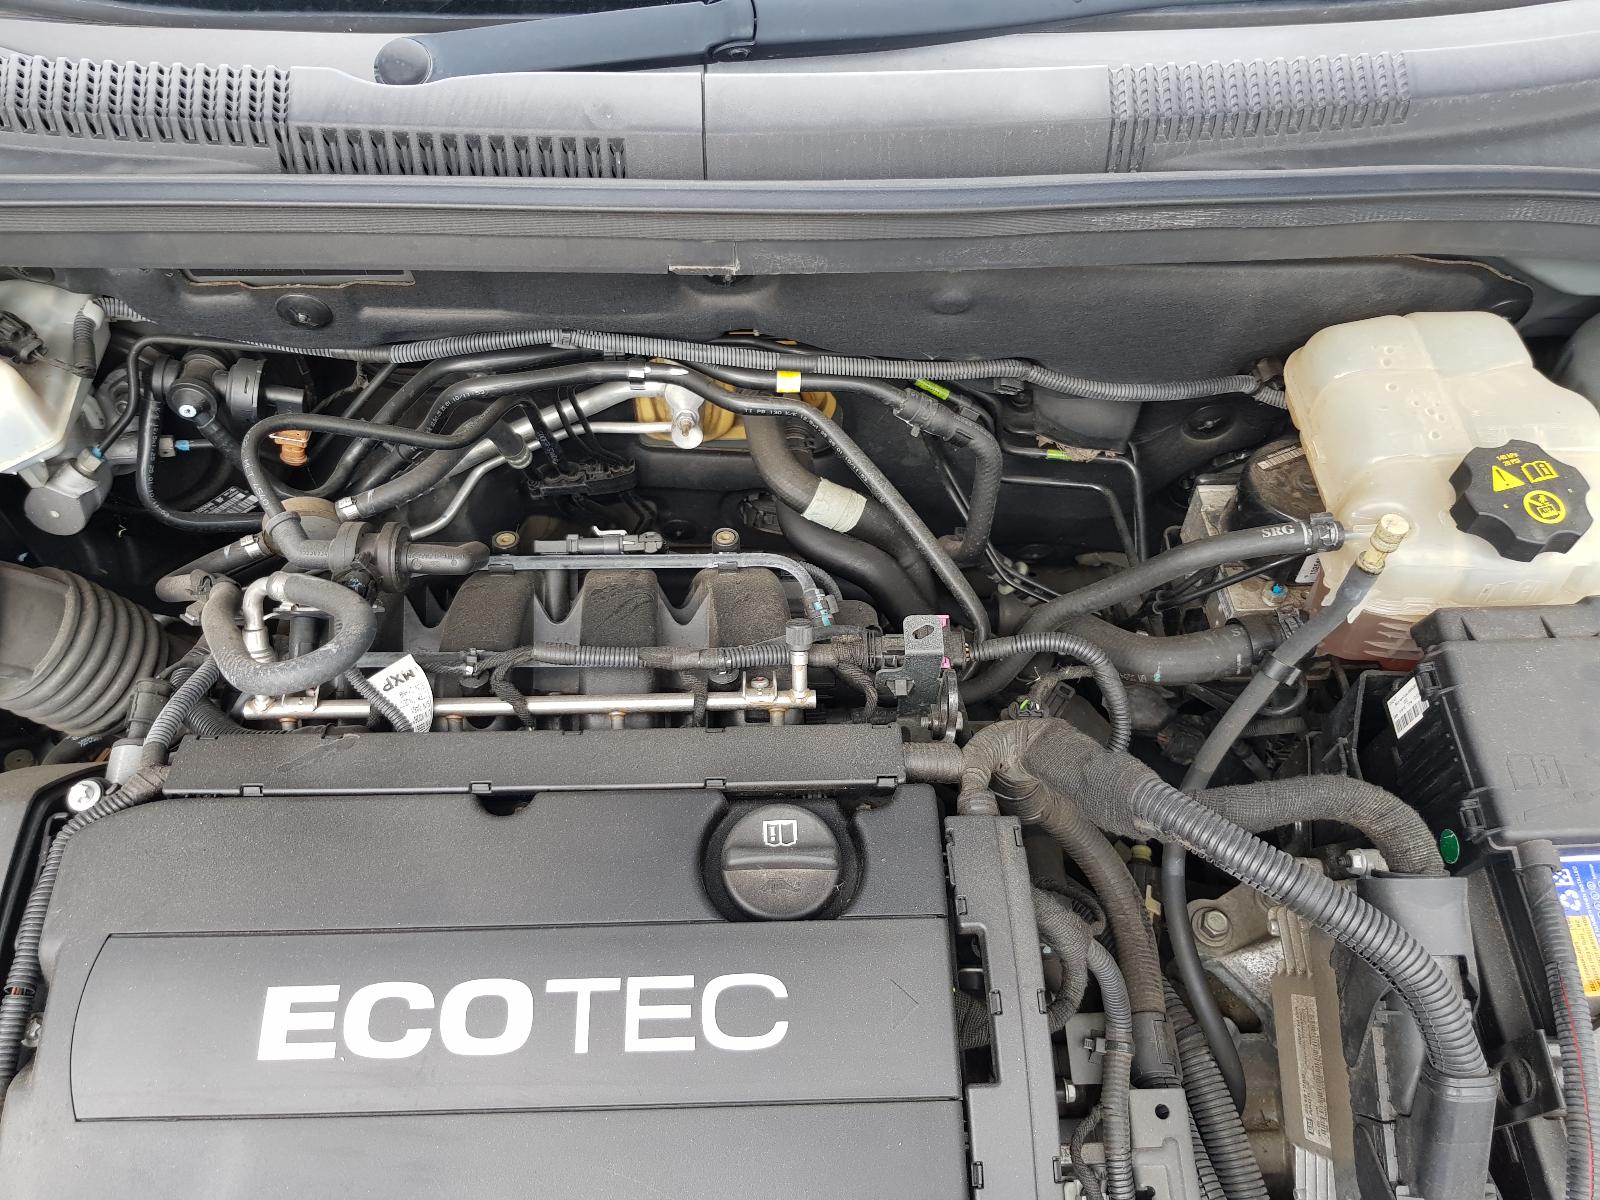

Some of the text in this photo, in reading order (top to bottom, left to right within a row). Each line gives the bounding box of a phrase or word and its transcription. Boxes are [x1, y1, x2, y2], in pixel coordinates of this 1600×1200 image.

[1261, 524, 1295, 538] SRG
[383, 669, 416, 692] MXP
[257, 973, 789, 1061] ECOTEC
